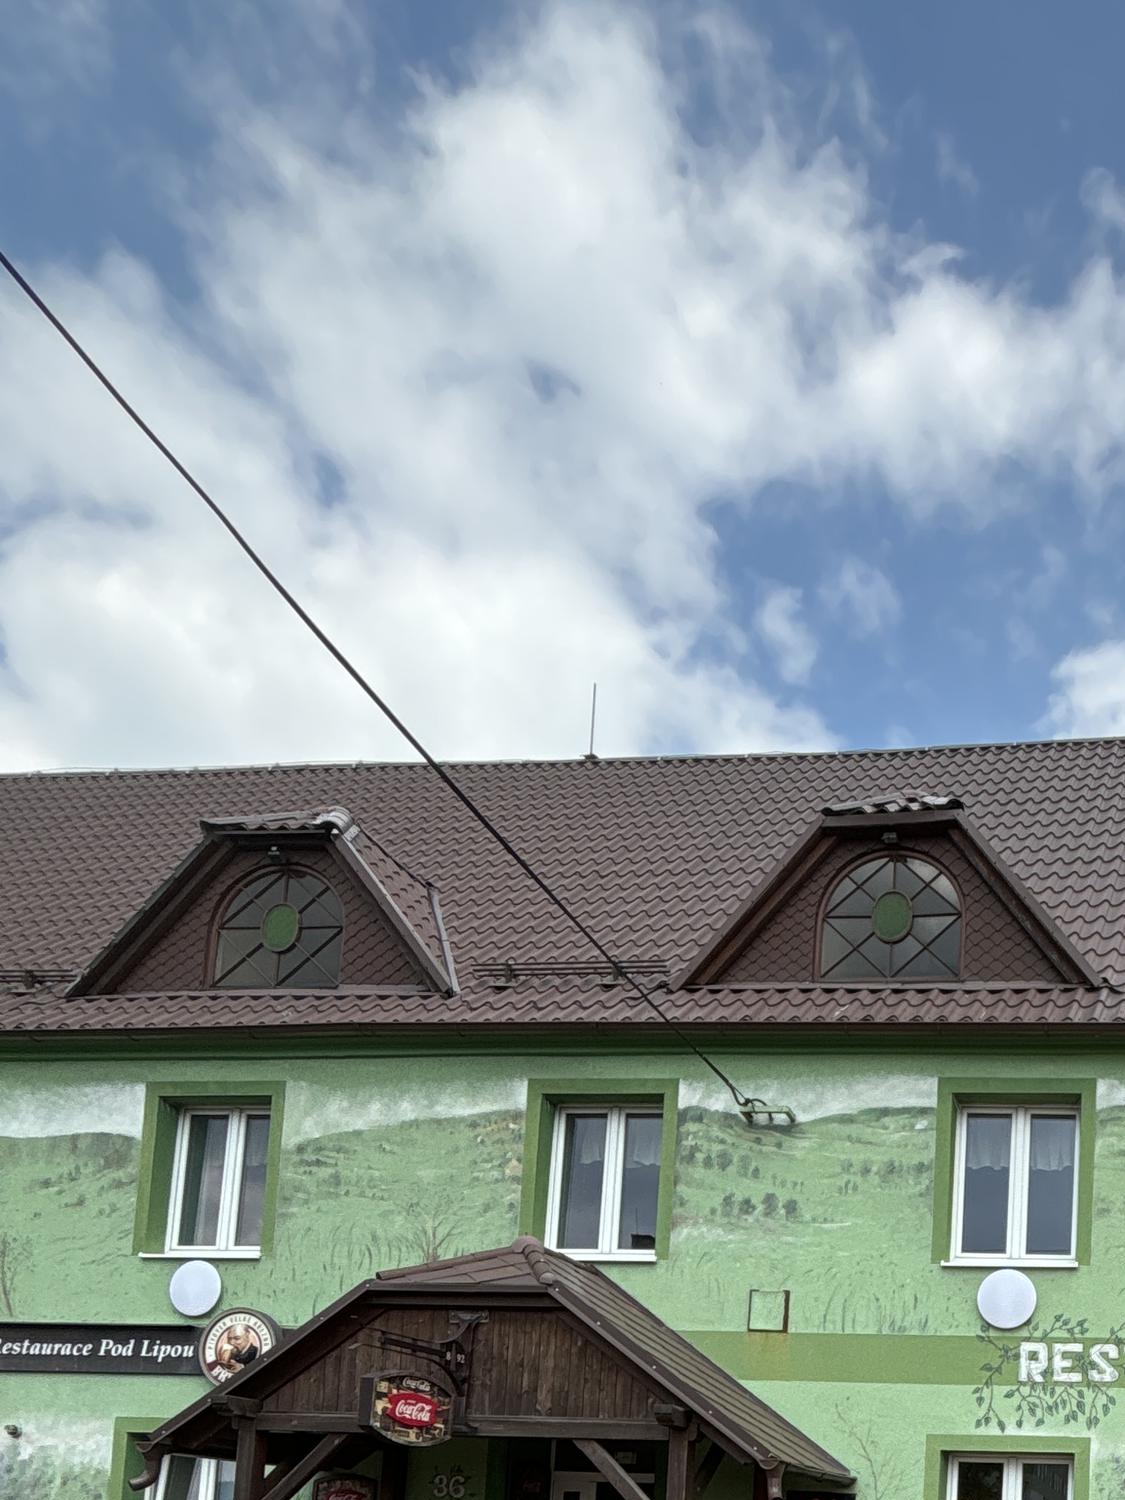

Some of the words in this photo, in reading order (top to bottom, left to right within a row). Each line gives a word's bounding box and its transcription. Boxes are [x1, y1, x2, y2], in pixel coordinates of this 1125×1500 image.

[0, 1338, 93, 1357] estaurace
[100, 1339, 134, 1357] Pod
[140, 1340, 195, 1363] Lipou
[432, 1474, 466, 1499] 36
